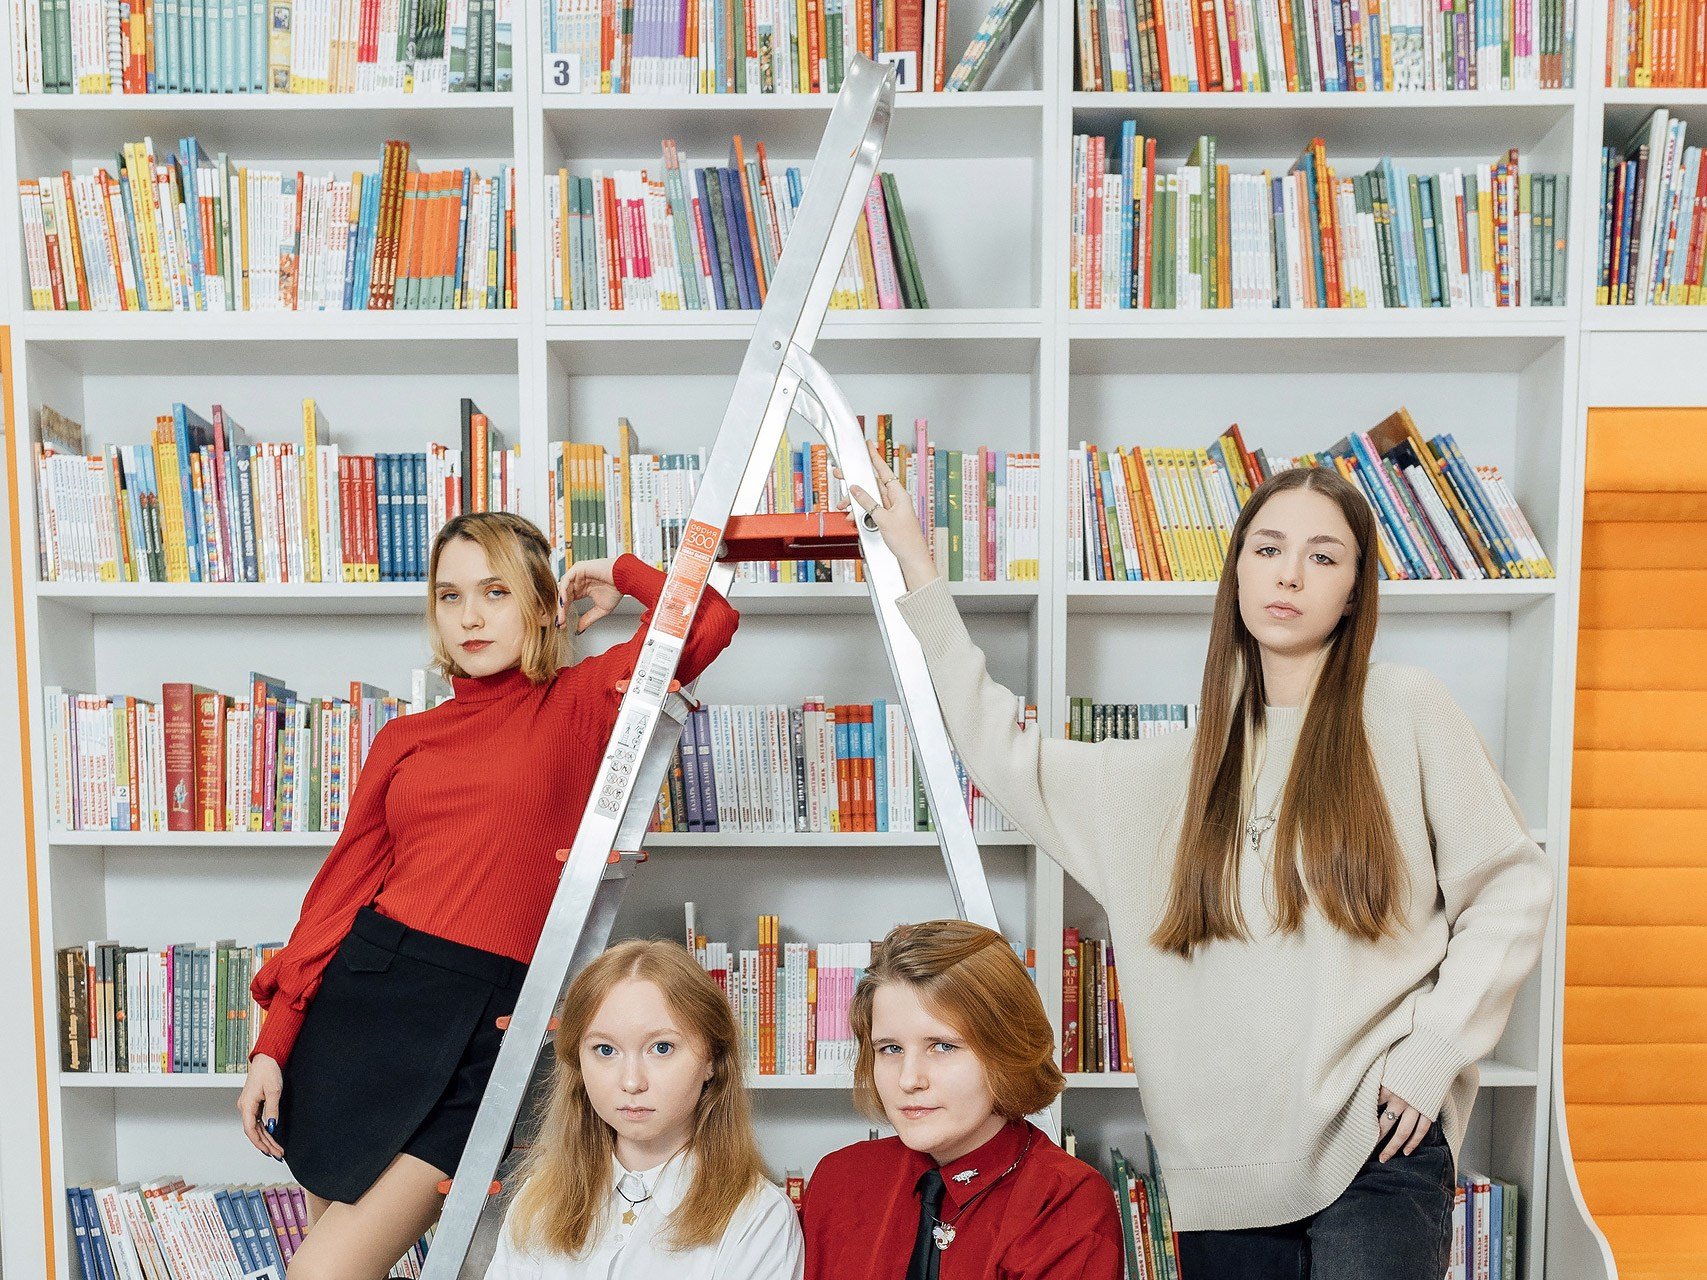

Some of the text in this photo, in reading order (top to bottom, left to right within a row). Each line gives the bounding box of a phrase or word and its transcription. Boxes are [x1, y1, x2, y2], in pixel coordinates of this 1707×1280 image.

[554, 60, 570, 86] 3
[691, 524, 718, 537] серия
[689, 531, 714, 549] 300
[119, 787, 127, 798] 2
[1505, 1235, 1513, 1261] ДРУЗЬЯ
